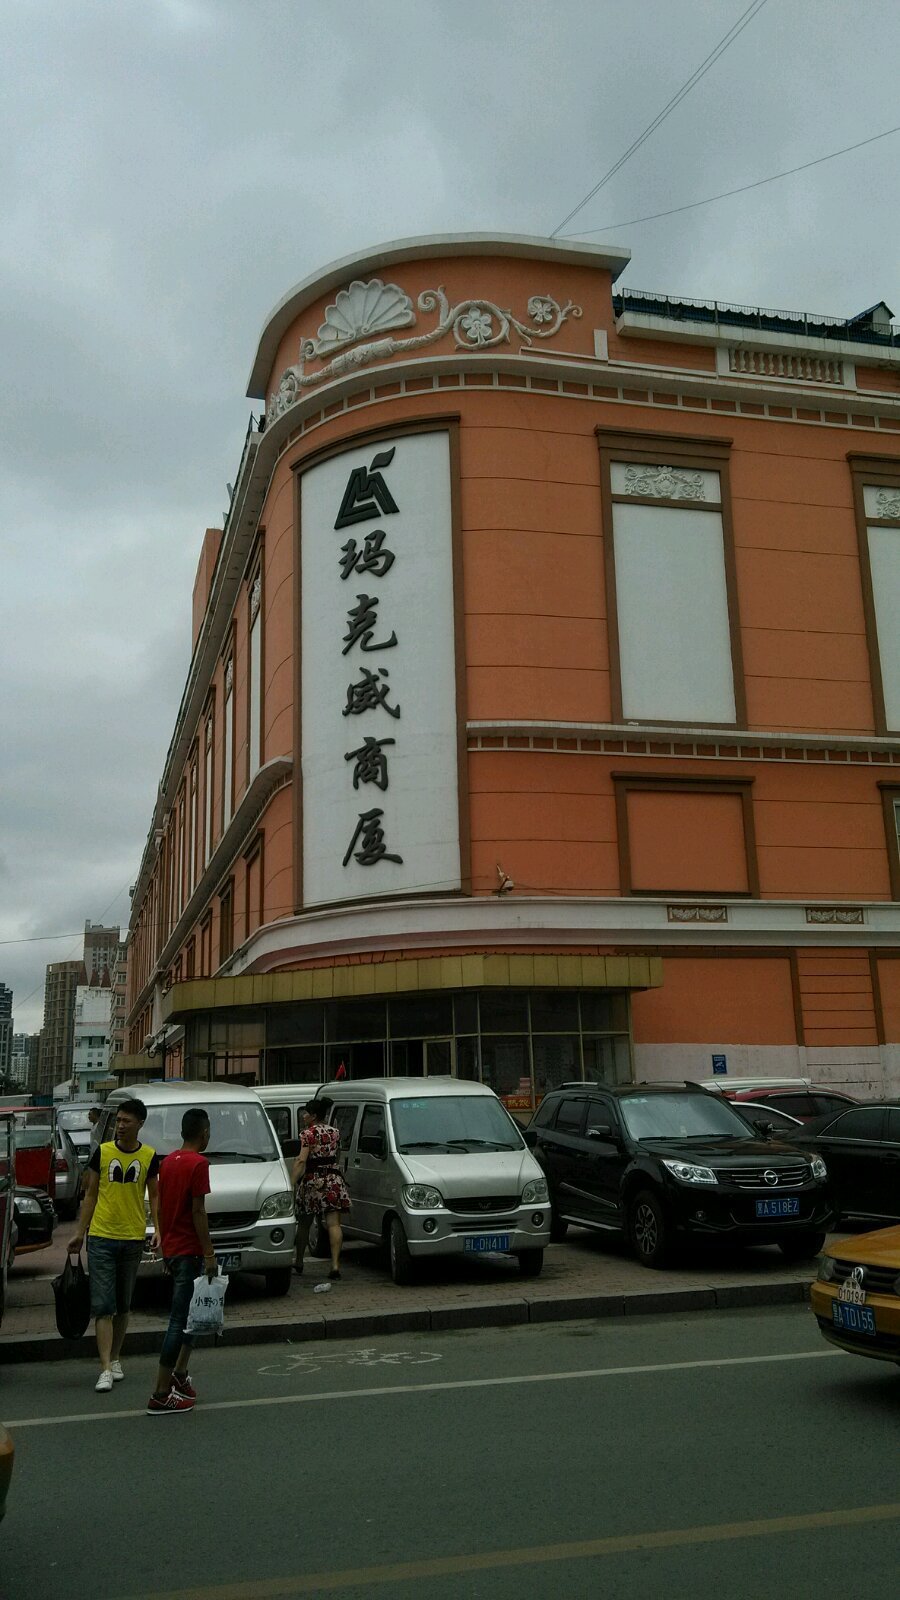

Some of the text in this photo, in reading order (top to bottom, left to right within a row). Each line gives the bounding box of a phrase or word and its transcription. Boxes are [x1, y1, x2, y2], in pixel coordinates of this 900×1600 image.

[338, 529, 404, 867] 玛克威商厦
